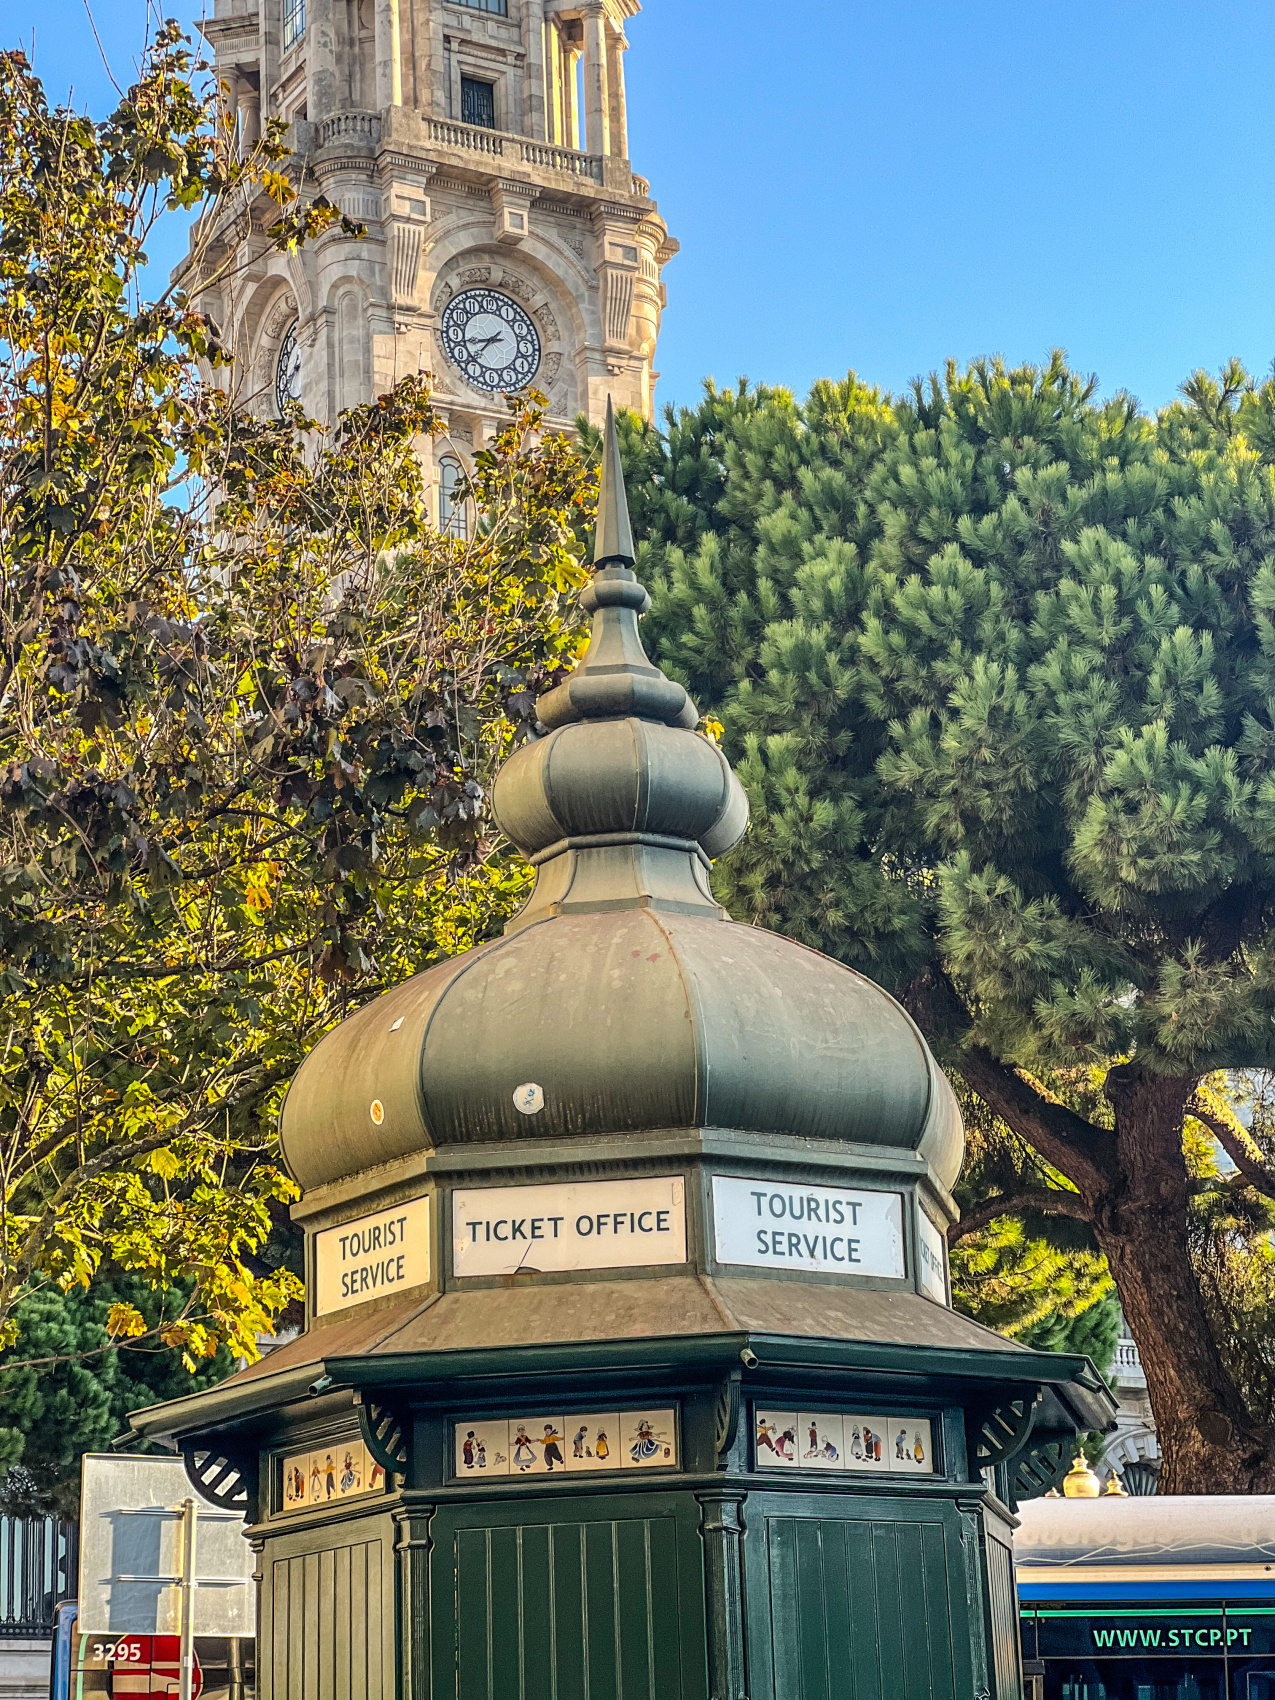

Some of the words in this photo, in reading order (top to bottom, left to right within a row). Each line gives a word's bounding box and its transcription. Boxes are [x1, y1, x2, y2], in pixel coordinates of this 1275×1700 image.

[468, 299, 476, 312] 11
[485, 298, 495, 311] 12
[456, 311, 464, 323] 10
[452, 328, 459, 340] 9
[517, 323, 524, 335] 2
[457, 348, 464, 360] 8
[523, 342, 529, 354] 3
[471, 363, 477, 376] 7
[518, 360, 525, 372] 4
[489, 372, 495, 383] 6
[506, 371, 513, 382] 5
[750, 1191, 863, 1226] TOURIST
[465, 1216, 565, 1242] TICKET
[575, 1210, 670, 1236] OFFICE
[338, 1216, 407, 1261] TOURIST
[756, 1229, 862, 1263] SERVICE
[341, 1254, 405, 1298] SERVICE
[1093, 1628, 1252, 1648] WWW.STCP.PT
[92, 1643, 141, 1661] 3295
